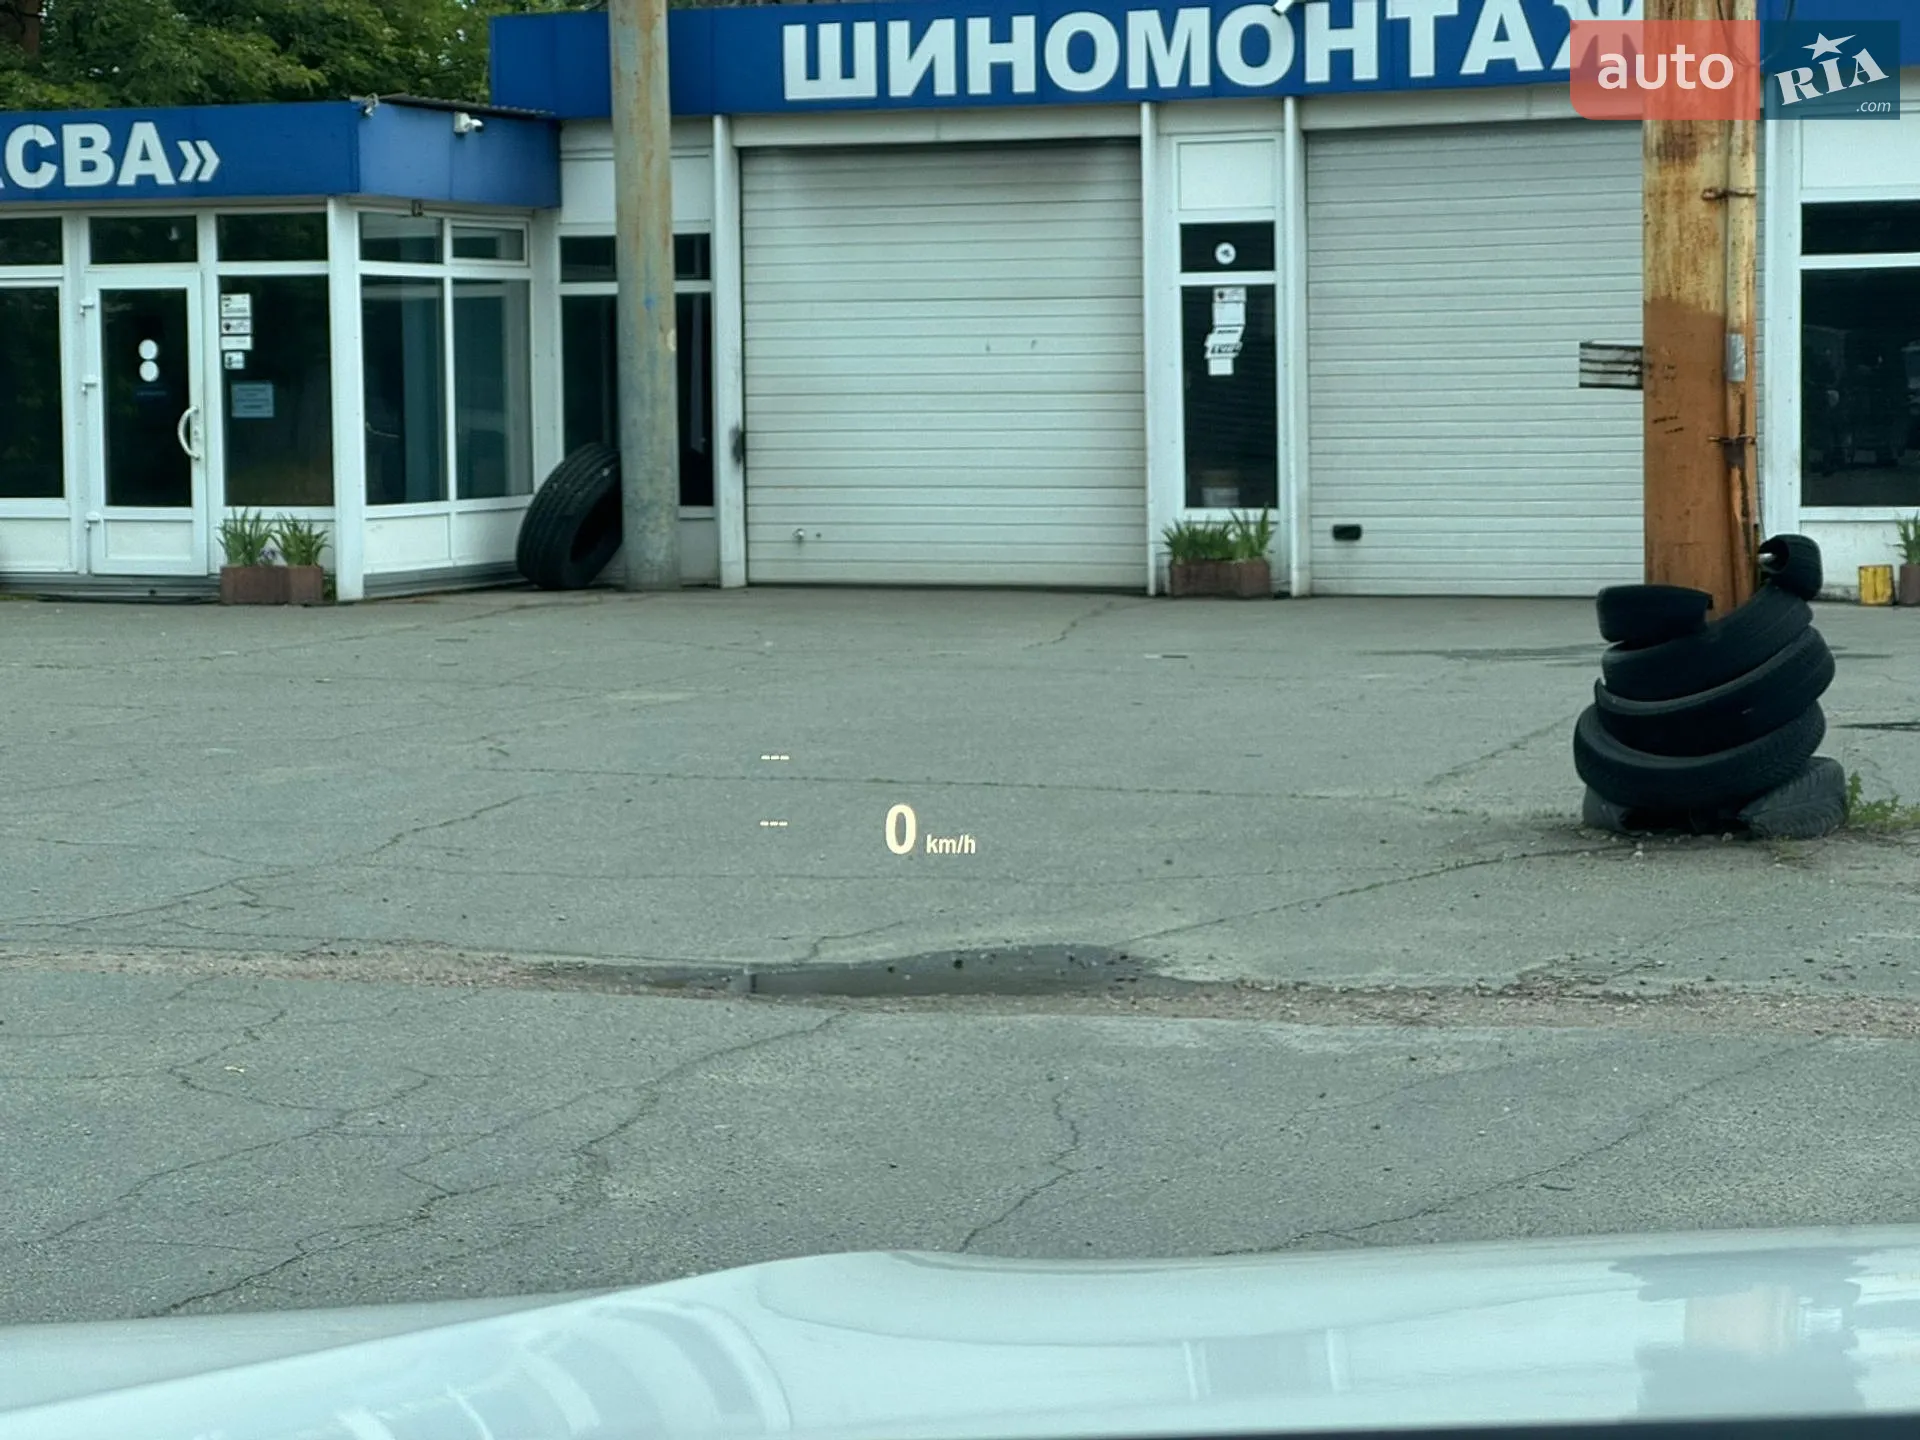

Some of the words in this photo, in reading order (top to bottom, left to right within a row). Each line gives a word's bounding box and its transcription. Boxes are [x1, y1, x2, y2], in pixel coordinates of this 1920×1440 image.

[783, 0, 1643, 100] ШИНОМОНТАЖ
[0, 121, 220, 189] СВА»
[885, 803, 917, 855] 0
[926, 834, 976, 854] km/h
